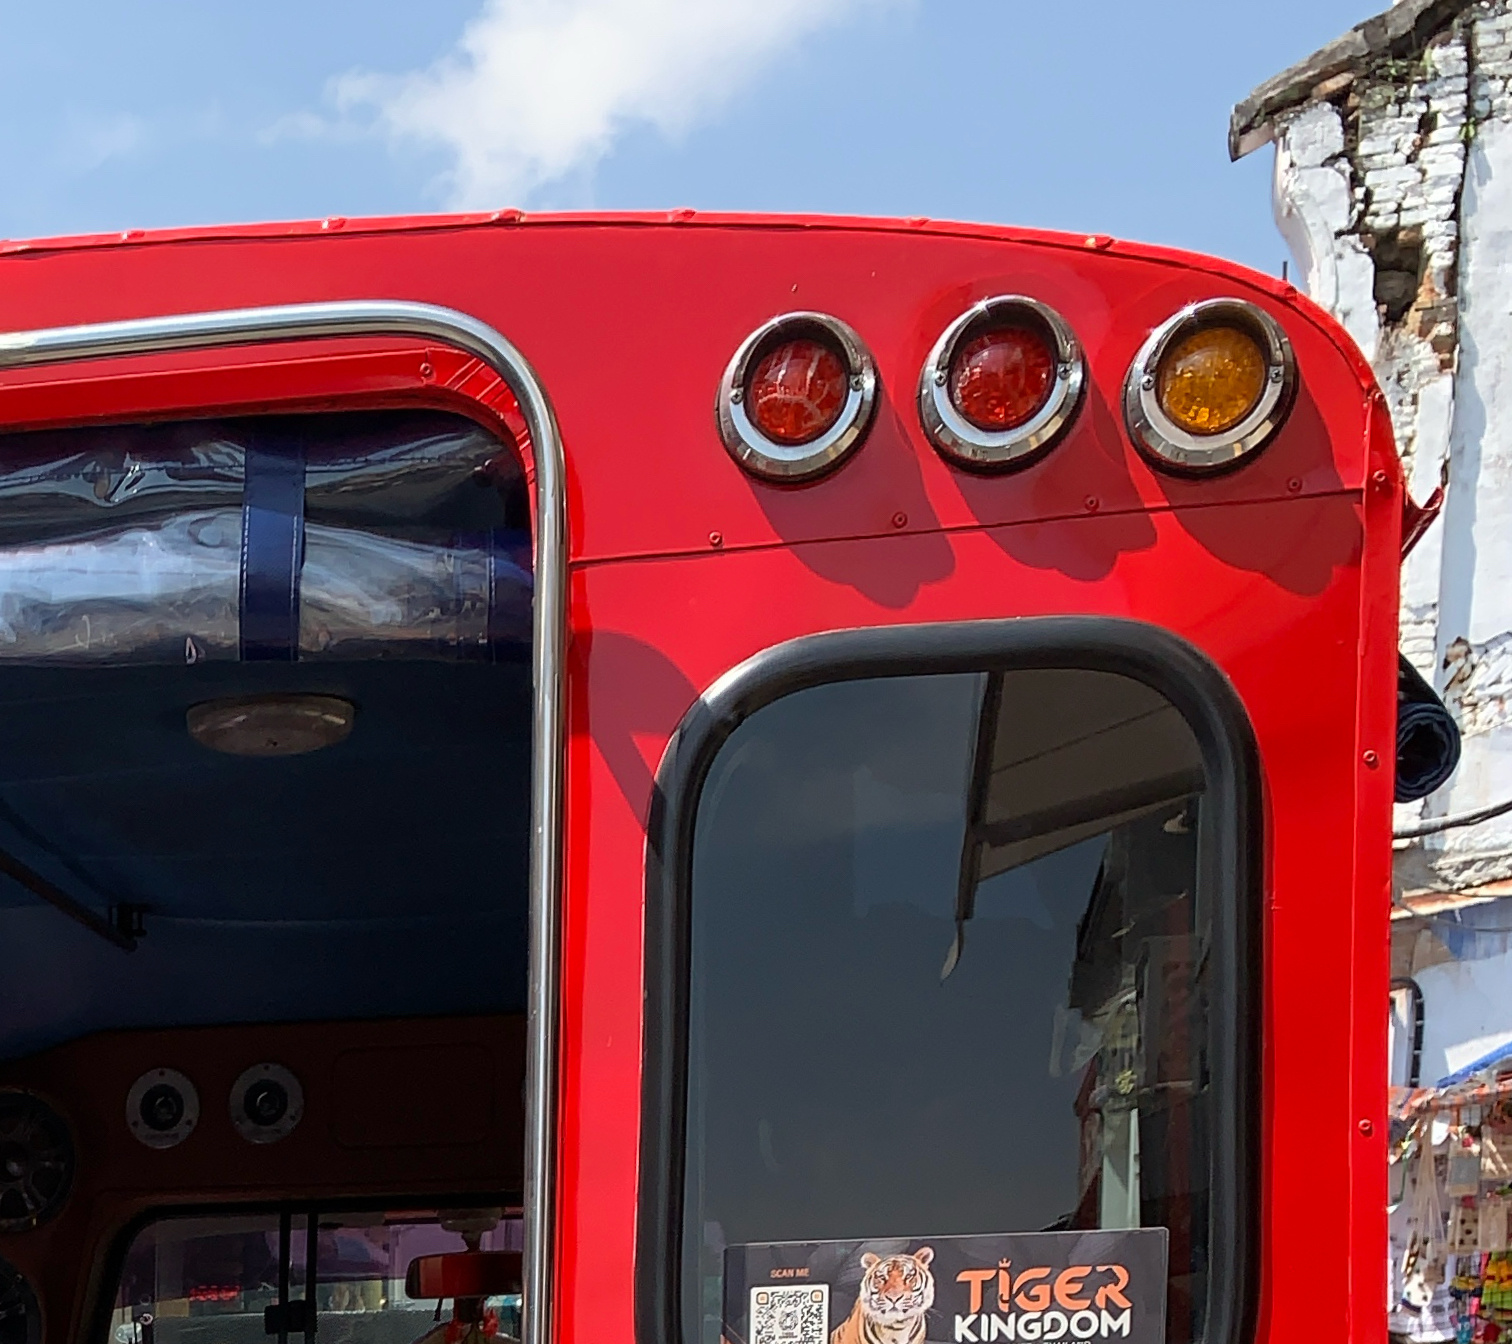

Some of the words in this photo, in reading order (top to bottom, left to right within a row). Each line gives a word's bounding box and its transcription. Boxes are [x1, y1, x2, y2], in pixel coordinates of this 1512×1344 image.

[770, 1268, 794, 1278] SCAN
[795, 1267, 810, 1277] ME
[955, 1264, 1133, 1314] TIGER
[954, 1309, 1132, 1343] KINGDOM
